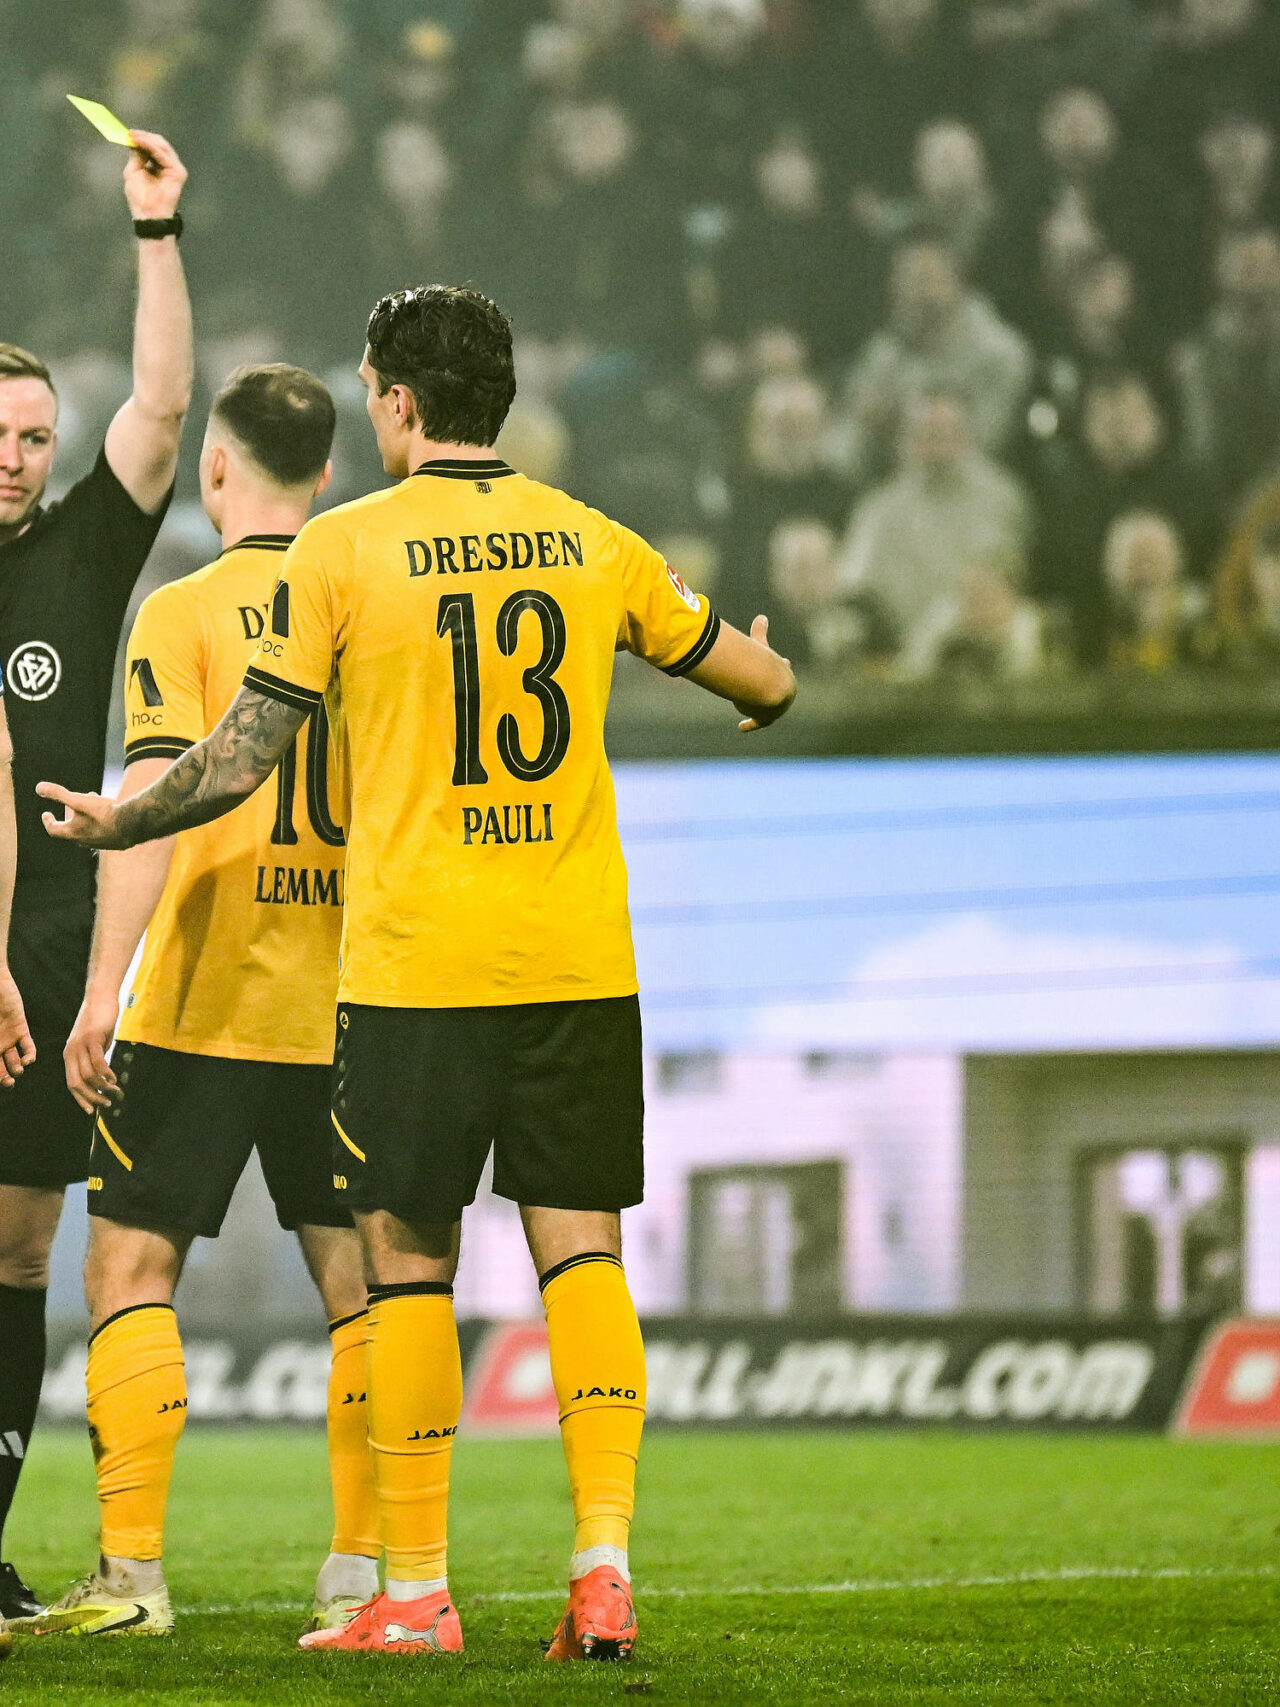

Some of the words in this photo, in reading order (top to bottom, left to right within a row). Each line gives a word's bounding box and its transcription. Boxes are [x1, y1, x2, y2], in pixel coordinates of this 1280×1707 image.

[405, 530, 585, 578] DRESDEN
[436, 589, 572, 787] 13
[132, 711, 163, 727] hoc
[462, 803, 554, 846] PAULI
[254, 865, 345, 907] LEMM
[572, 1387, 637, 1402] JAKO
